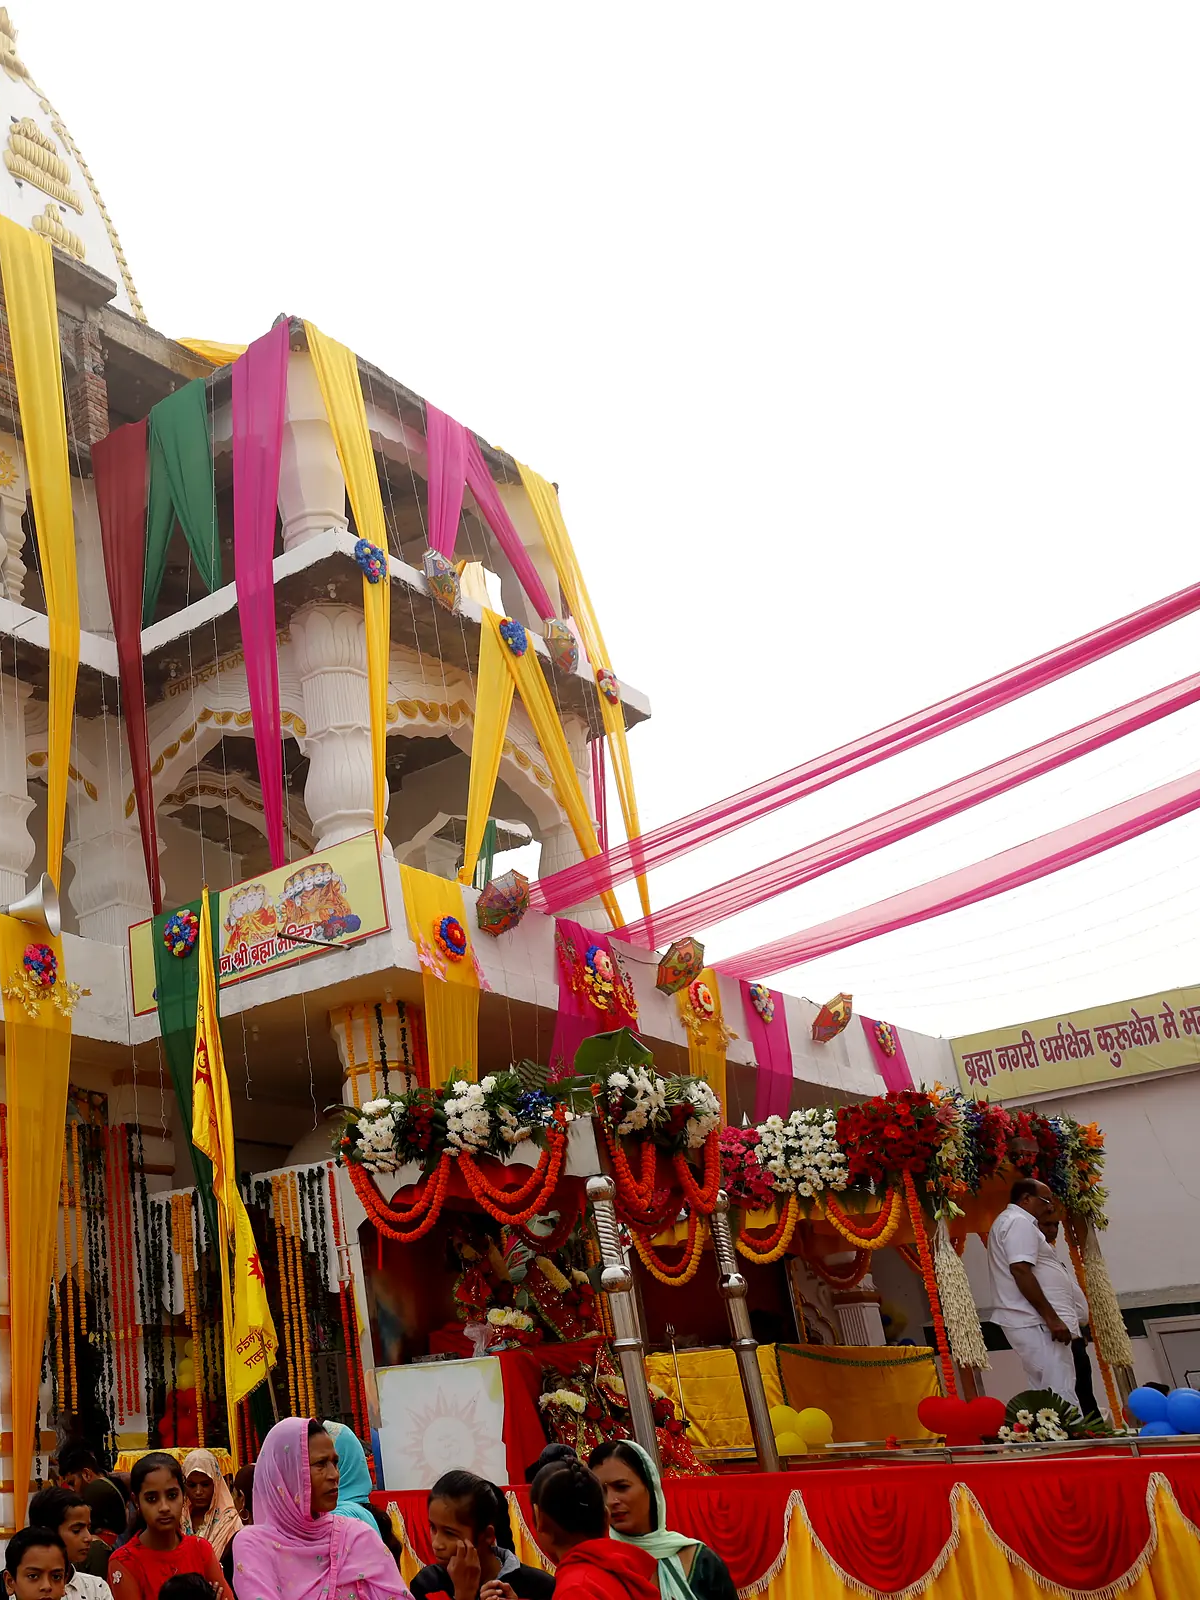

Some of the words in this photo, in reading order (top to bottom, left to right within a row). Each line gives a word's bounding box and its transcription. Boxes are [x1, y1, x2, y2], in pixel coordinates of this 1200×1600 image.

[234, 943, 248, 966] श्री
[251, 939, 274, 965] ब्रह्मा
[962, 1050, 996, 1086] ब्रह्मा
[995, 1030, 1040, 1072] नगरी
[1040, 1022, 1095, 1063] धर्मक्षेत्र
